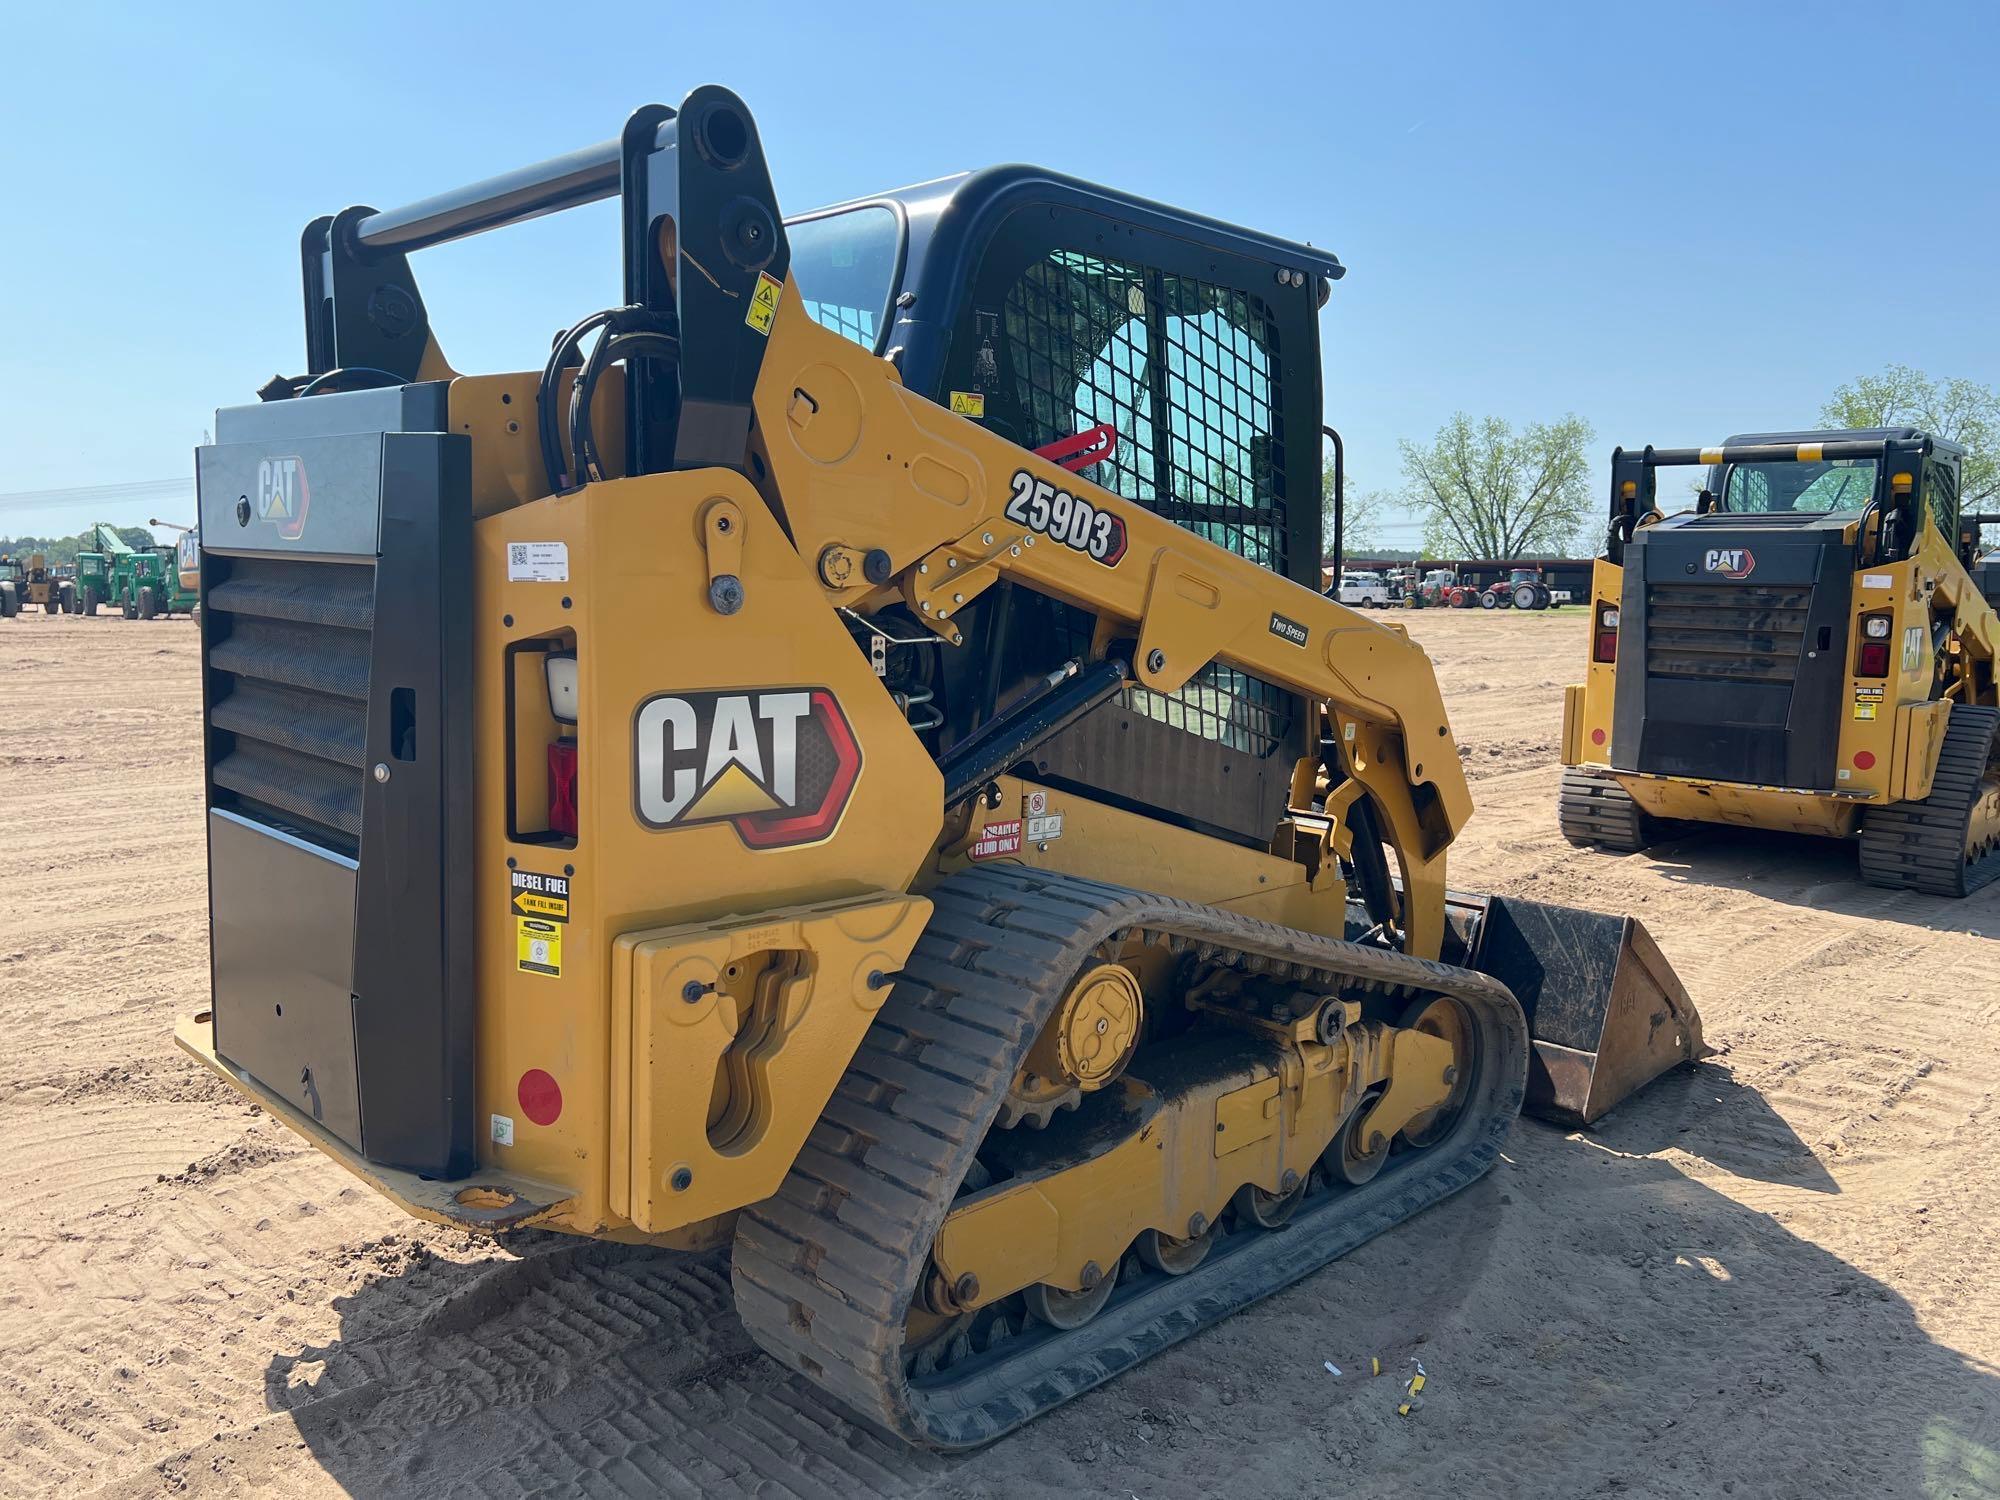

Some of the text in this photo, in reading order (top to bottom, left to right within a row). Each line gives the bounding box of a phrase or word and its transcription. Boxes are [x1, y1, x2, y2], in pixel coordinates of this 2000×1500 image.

[258, 460, 296, 518] CAT
[1006, 471, 1113, 558] 259D3
[1705, 549, 1743, 571] CAT
[1902, 628, 1924, 671] CAT
[637, 692, 810, 823] CAT
[975, 837, 1020, 856] FLUID ONLY
[512, 872, 568, 895] DIESEL FUEL
[523, 897, 565, 912] TANK FILL INSIDE
